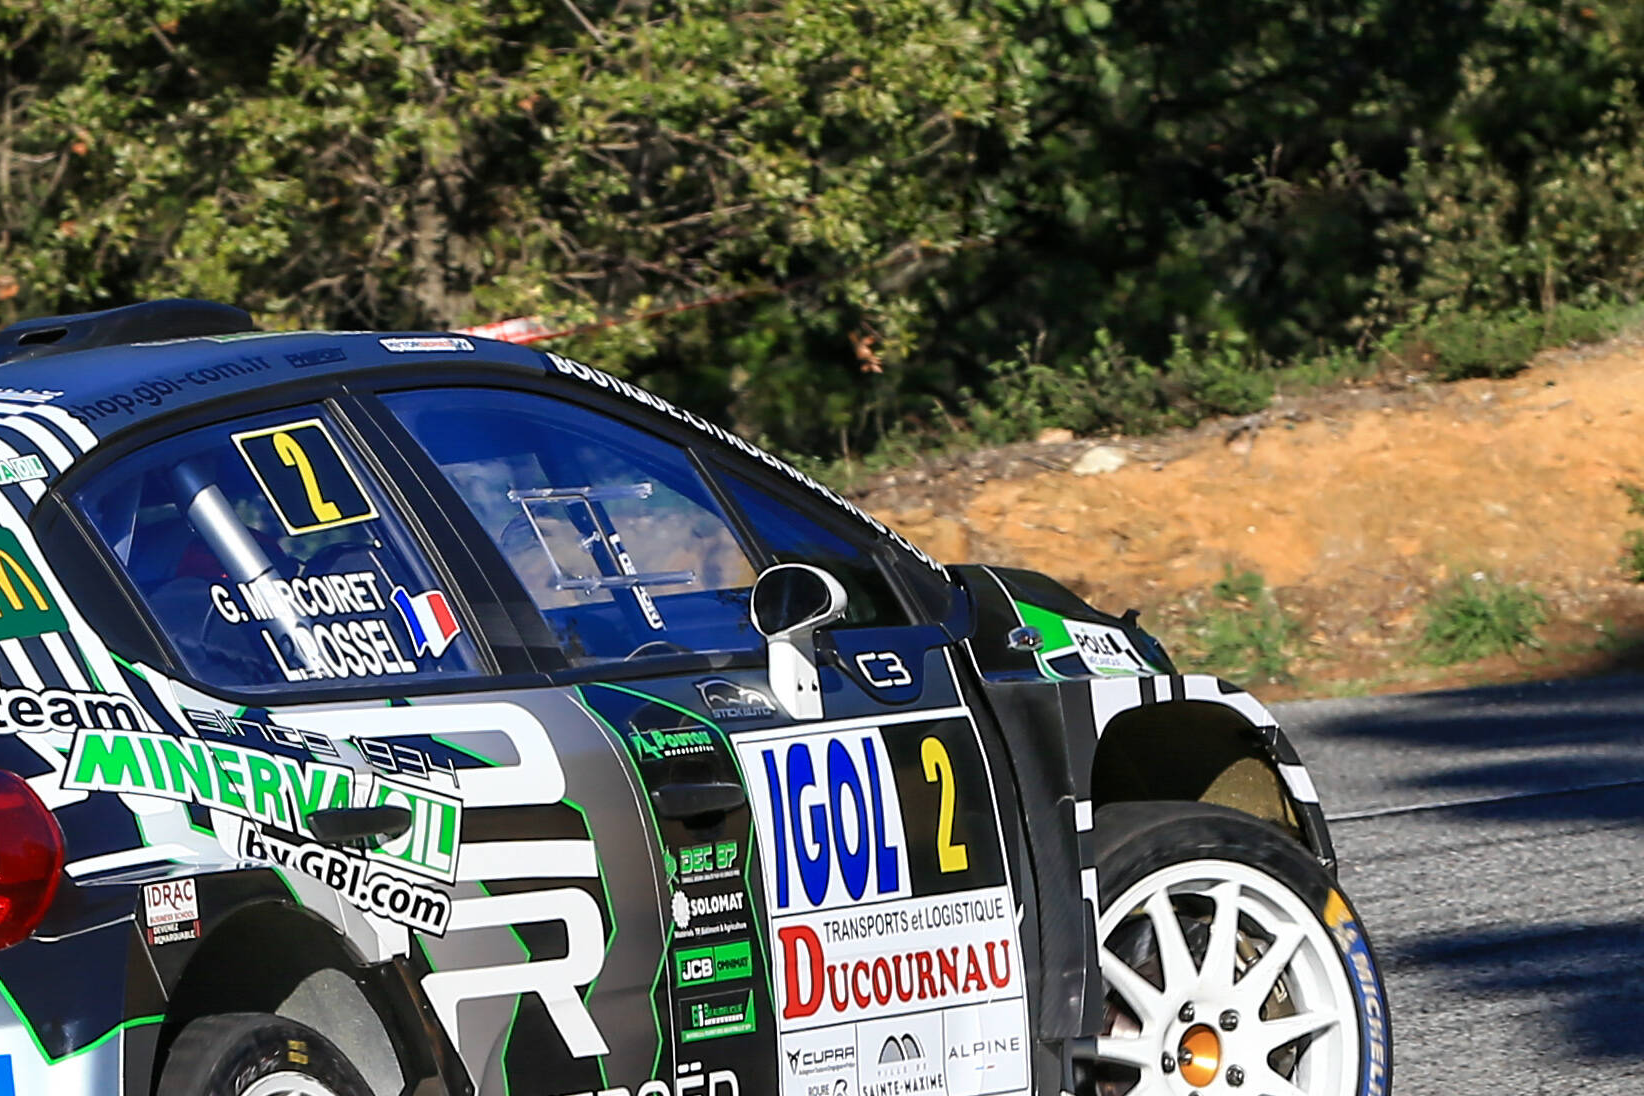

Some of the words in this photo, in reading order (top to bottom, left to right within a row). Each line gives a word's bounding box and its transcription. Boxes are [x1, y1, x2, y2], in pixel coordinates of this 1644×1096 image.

[16, 457, 45, 478] OIL
[273, 432, 342, 523] 2
[856, 651, 913, 688] C3
[75, 734, 354, 836] MINERVA
[761, 737, 899, 907] IGOL
[921, 736, 969, 873] 2
[680, 846, 713, 874] DEC
[147, 880, 194, 910] IDRAC
[690, 892, 744, 917] SOLOMAT
[824, 910, 909, 943] TRANSPORTS
[911, 913, 924, 931] et
[927, 898, 1005, 929] LOGISTIQUE
[682, 957, 714, 981] JCB
[778, 925, 1011, 1020] DUCOURNAU
[803, 1046, 854, 1066] CUPRA
[948, 1037, 1020, 1060] ALPINE
